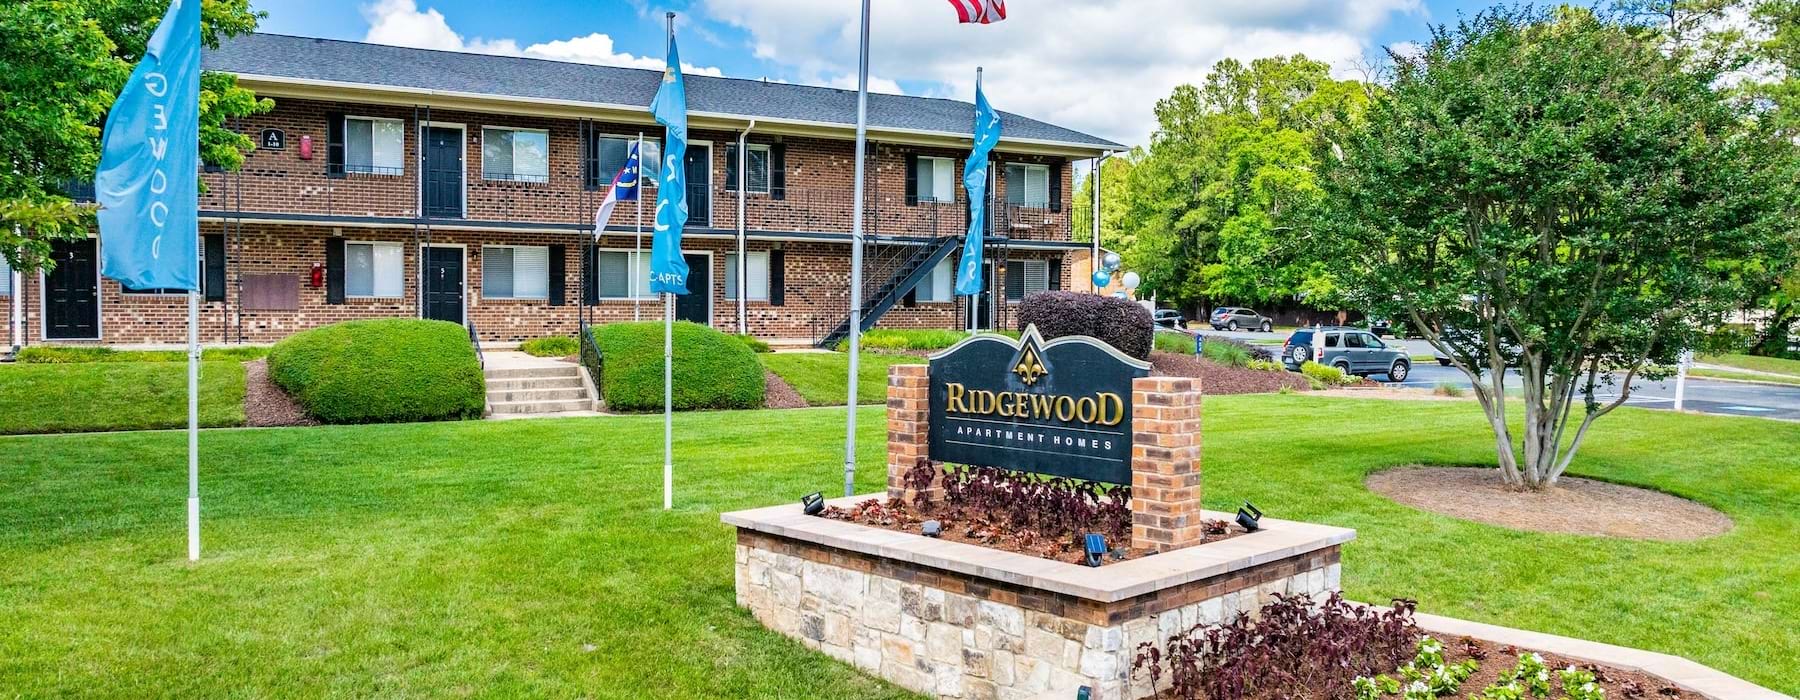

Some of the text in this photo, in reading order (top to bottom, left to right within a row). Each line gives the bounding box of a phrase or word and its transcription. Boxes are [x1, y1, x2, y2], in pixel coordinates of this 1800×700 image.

[268, 132, 279, 141] A
[945, 382, 1125, 426] RIDGEWOOD
[957, 426, 1112, 450] APARTMENT HOMES
